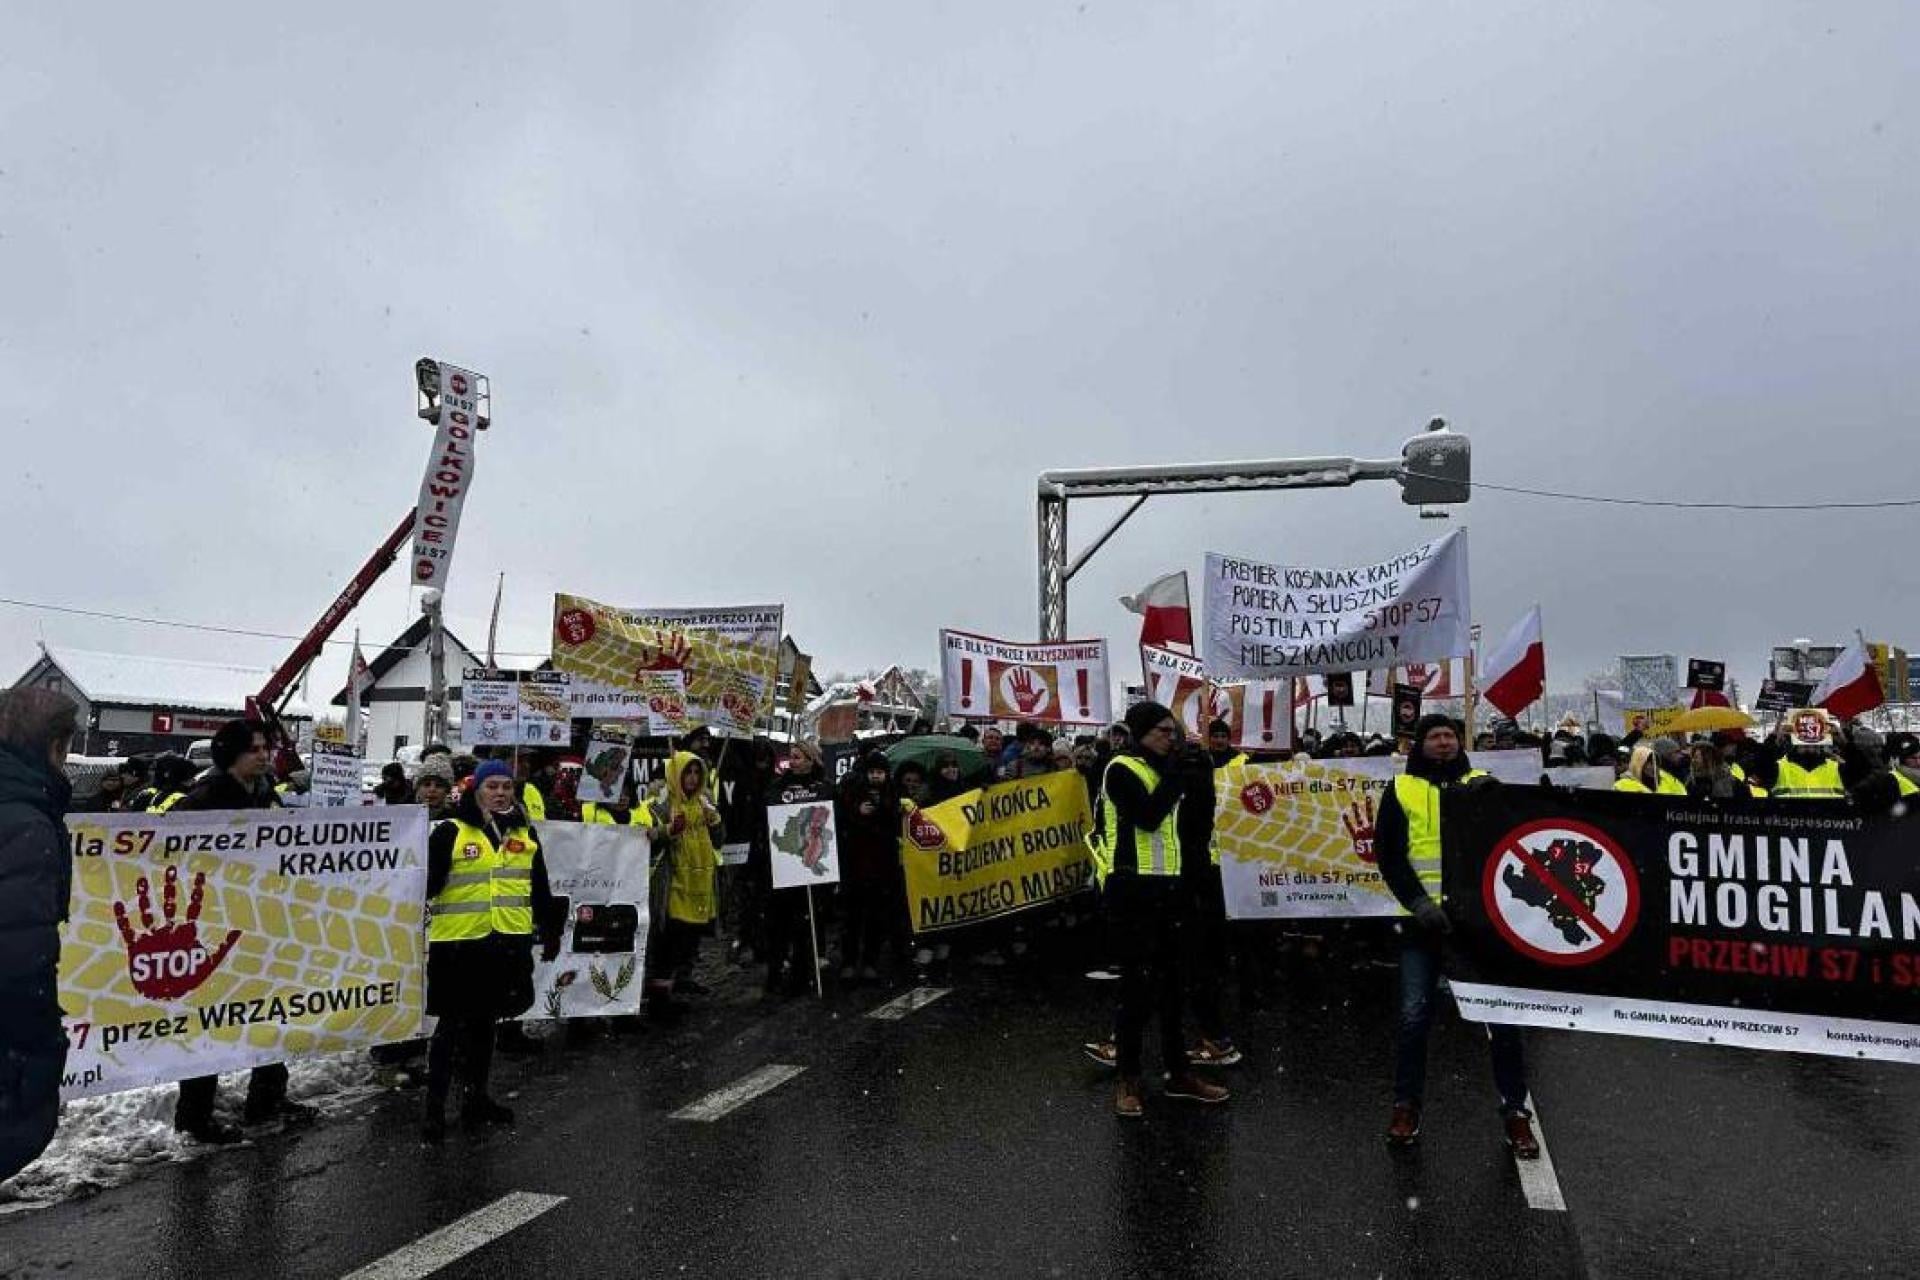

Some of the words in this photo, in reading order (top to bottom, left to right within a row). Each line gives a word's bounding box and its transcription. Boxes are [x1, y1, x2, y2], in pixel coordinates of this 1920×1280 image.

[420, 410, 470, 545] GOLKOWICE
[1284, 544, 1433, 590] KOSINIAK-KAMYSZ
[1232, 585, 1298, 614] POPIERA
[1306, 581, 1400, 614] SŁUSZNE
[700, 612, 779, 624] RZESZOTARY
[1231, 614, 1340, 639] POSTULATY
[1364, 602, 1415, 631] STOP
[1417, 598, 1442, 623] S7
[1275, 781, 1304, 796] NIE!
[1310, 780, 1332, 794] dla
[1337, 778, 1356, 791] S7
[962, 801, 985, 826] DO
[1666, 809, 1719, 825] Kolejna
[1723, 811, 1760, 825] trasa
[1764, 814, 1864, 831] ekspresowa?
[70, 831, 104, 857] la
[113, 830, 156, 855] S7
[164, 832, 246, 859] przez
[256, 821, 391, 848] POŁUDNIE
[1574, 863, 1590, 873] S7
[1668, 831, 1853, 886] GMINA
[1259, 873, 1289, 887] NIE!
[1294, 872, 1317, 884] dla
[1322, 871, 1341, 884] S7
[920, 879, 1015, 925] NASZEGO
[132, 948, 206, 982] STOP
[1670, 935, 1811, 978] PRZECIW
[1819, 948, 1859, 982] S7
[1872, 957, 1882, 985] i
[64, 1022, 91, 1050] 7
[103, 1017, 188, 1051] przez
[199, 981, 402, 1031] WRZĄSOWICE!
[1630, 1011, 1667, 1024] GMINA
[1670, 1014, 1728, 1030] MOGILANY
[1732, 1020, 1782, 1035] PRZECIW
[1785, 1025, 1799, 1036] S7
